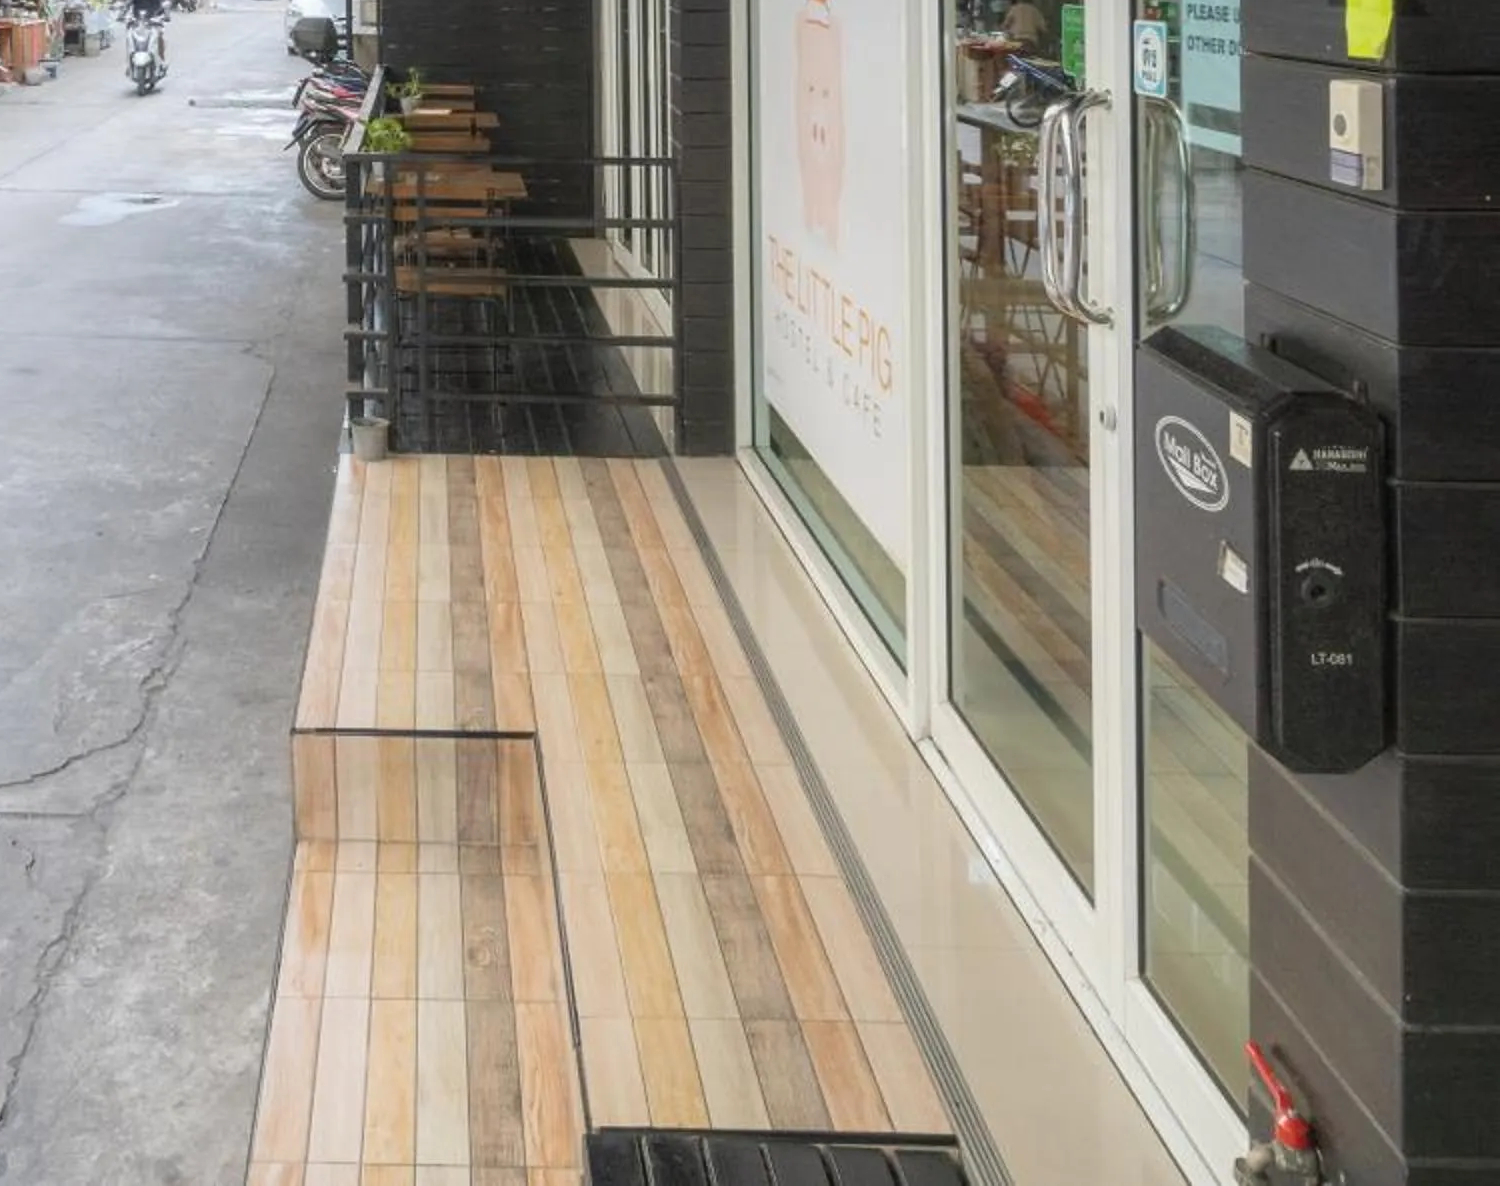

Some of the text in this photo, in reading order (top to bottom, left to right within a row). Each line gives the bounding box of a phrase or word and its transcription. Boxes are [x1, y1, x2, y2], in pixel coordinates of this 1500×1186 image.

[1187, 3, 1230, 23] PLEASE
[1187, 34, 1226, 55] OTHER
[859, 307, 893, 395] PIG
[1192, 451, 1219, 491] Box
